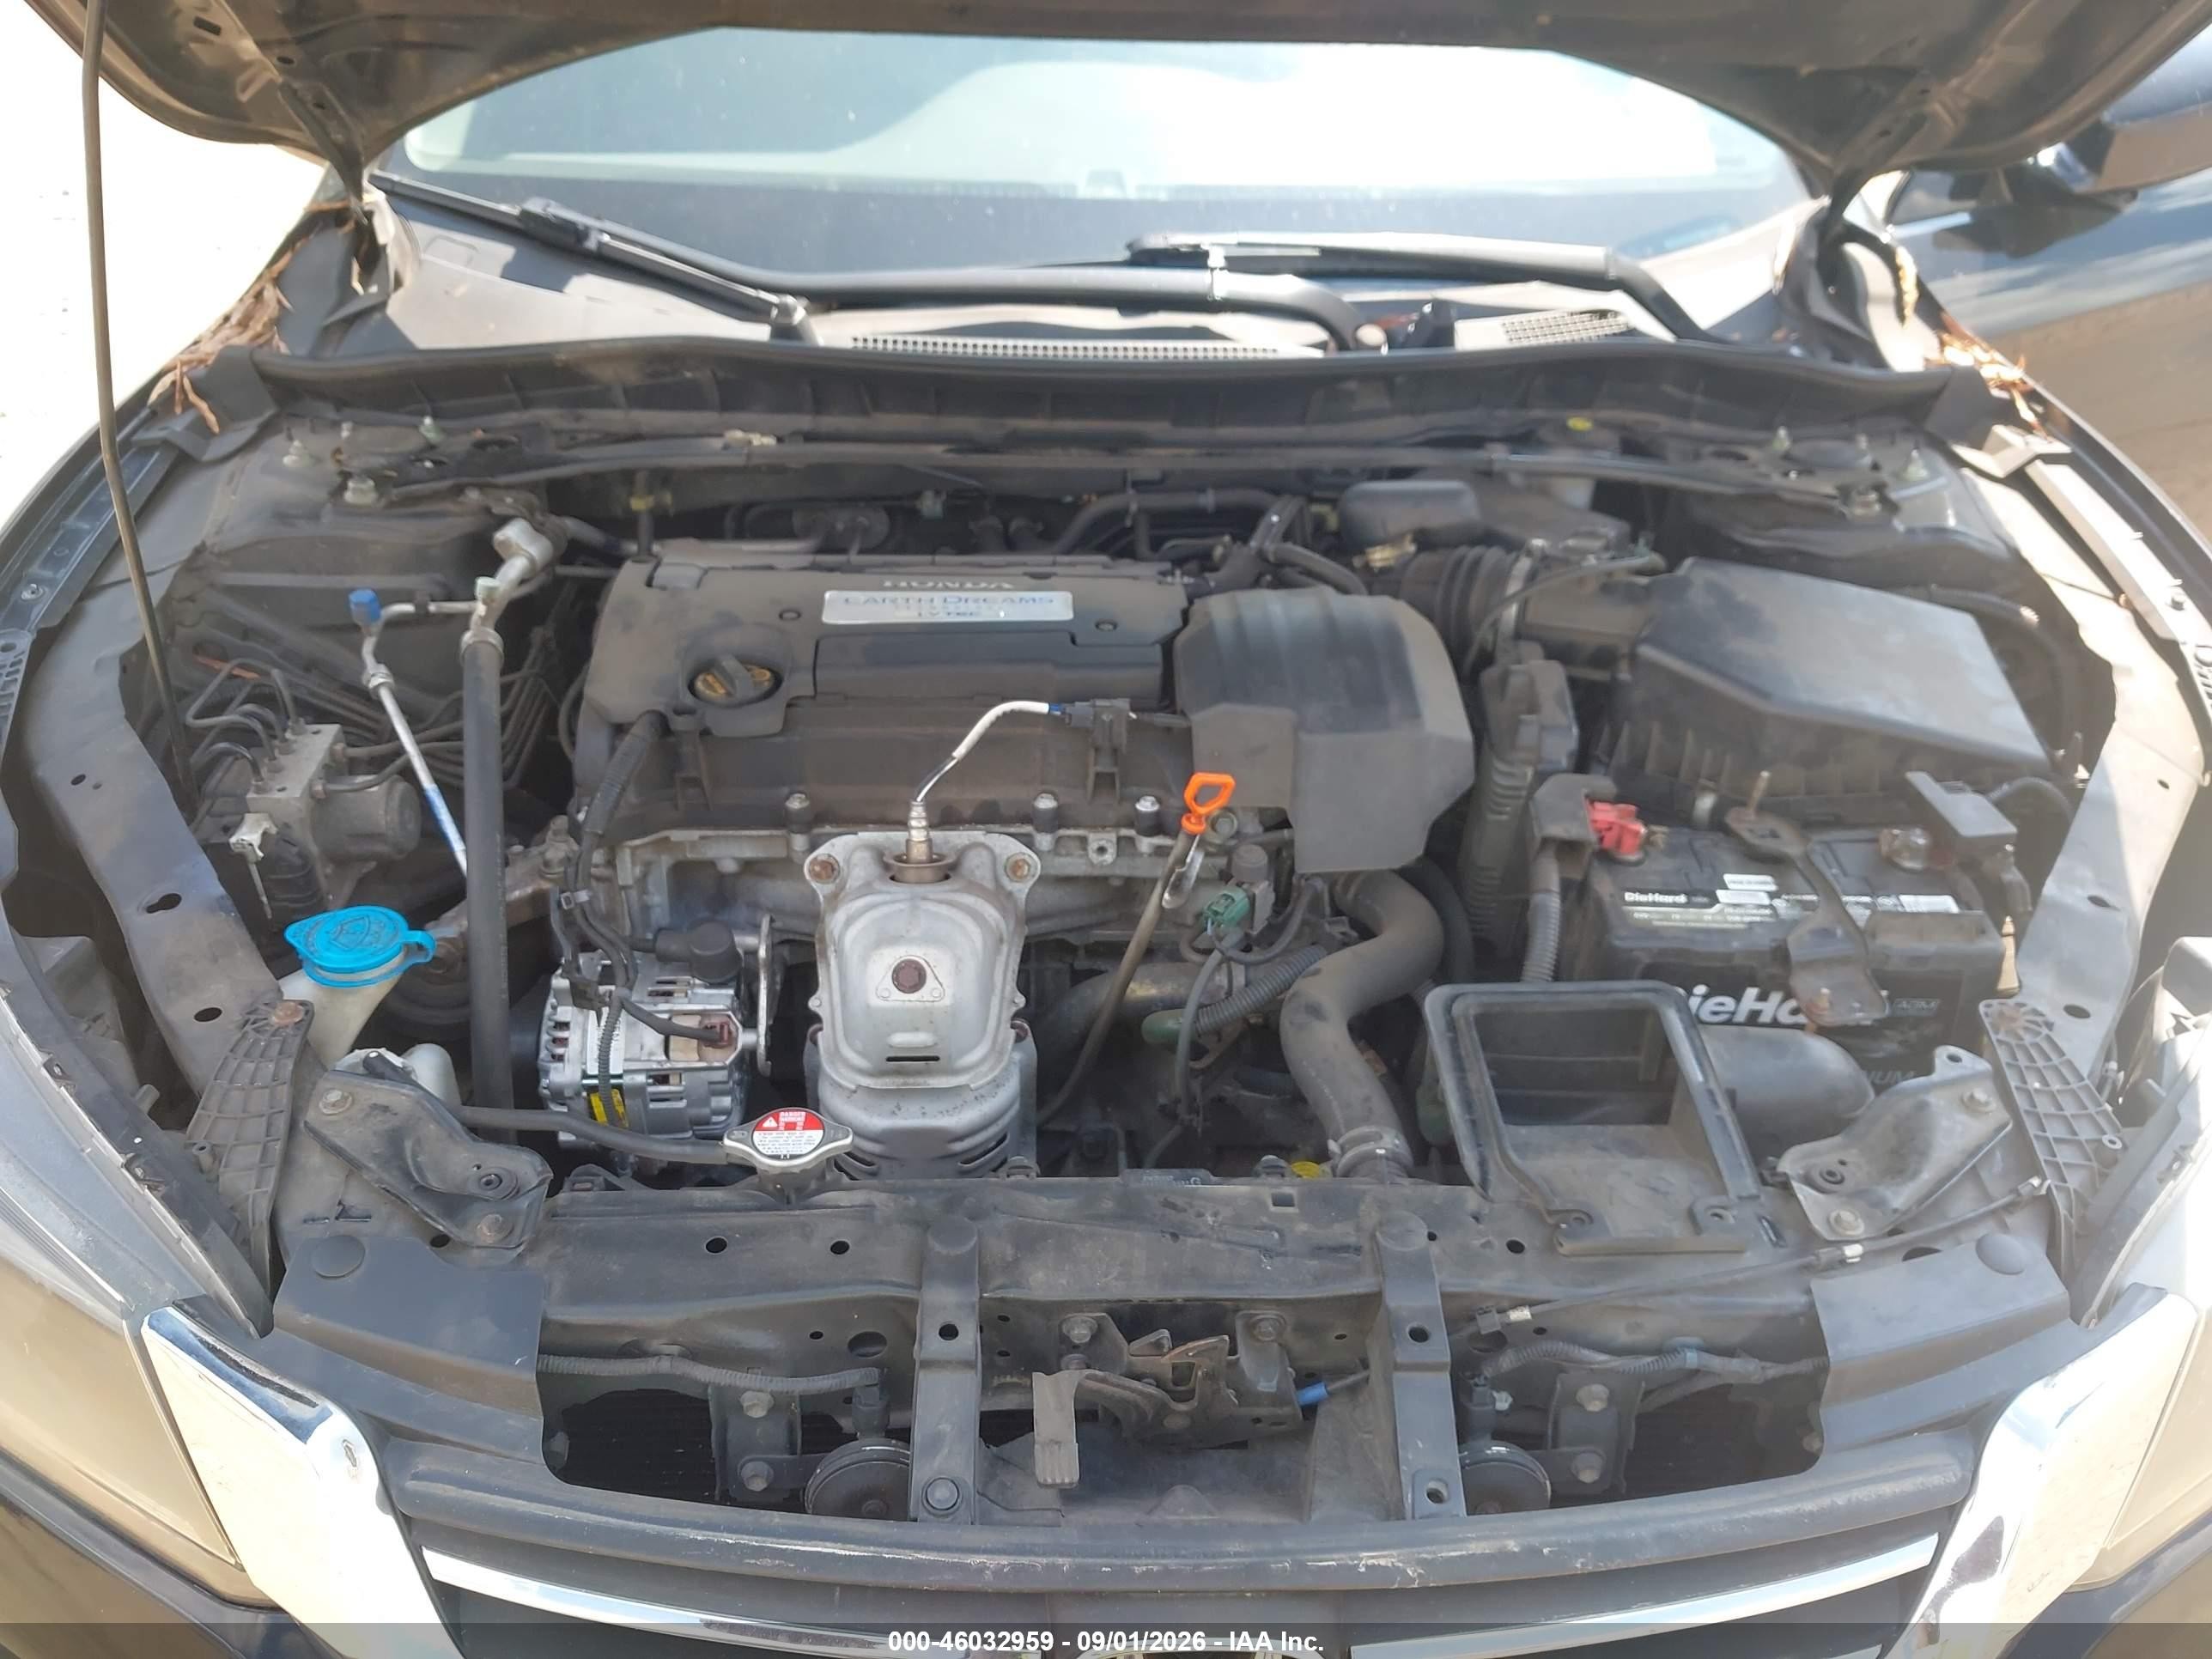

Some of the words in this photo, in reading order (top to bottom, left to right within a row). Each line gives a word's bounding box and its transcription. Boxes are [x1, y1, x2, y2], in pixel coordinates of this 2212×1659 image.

[883, 580, 1014, 590] HONDA
[843, 596, 935, 605] EARTH
[943, 595, 1054, 605] DREAMS
[1624, 891, 1689, 904] DieHard
